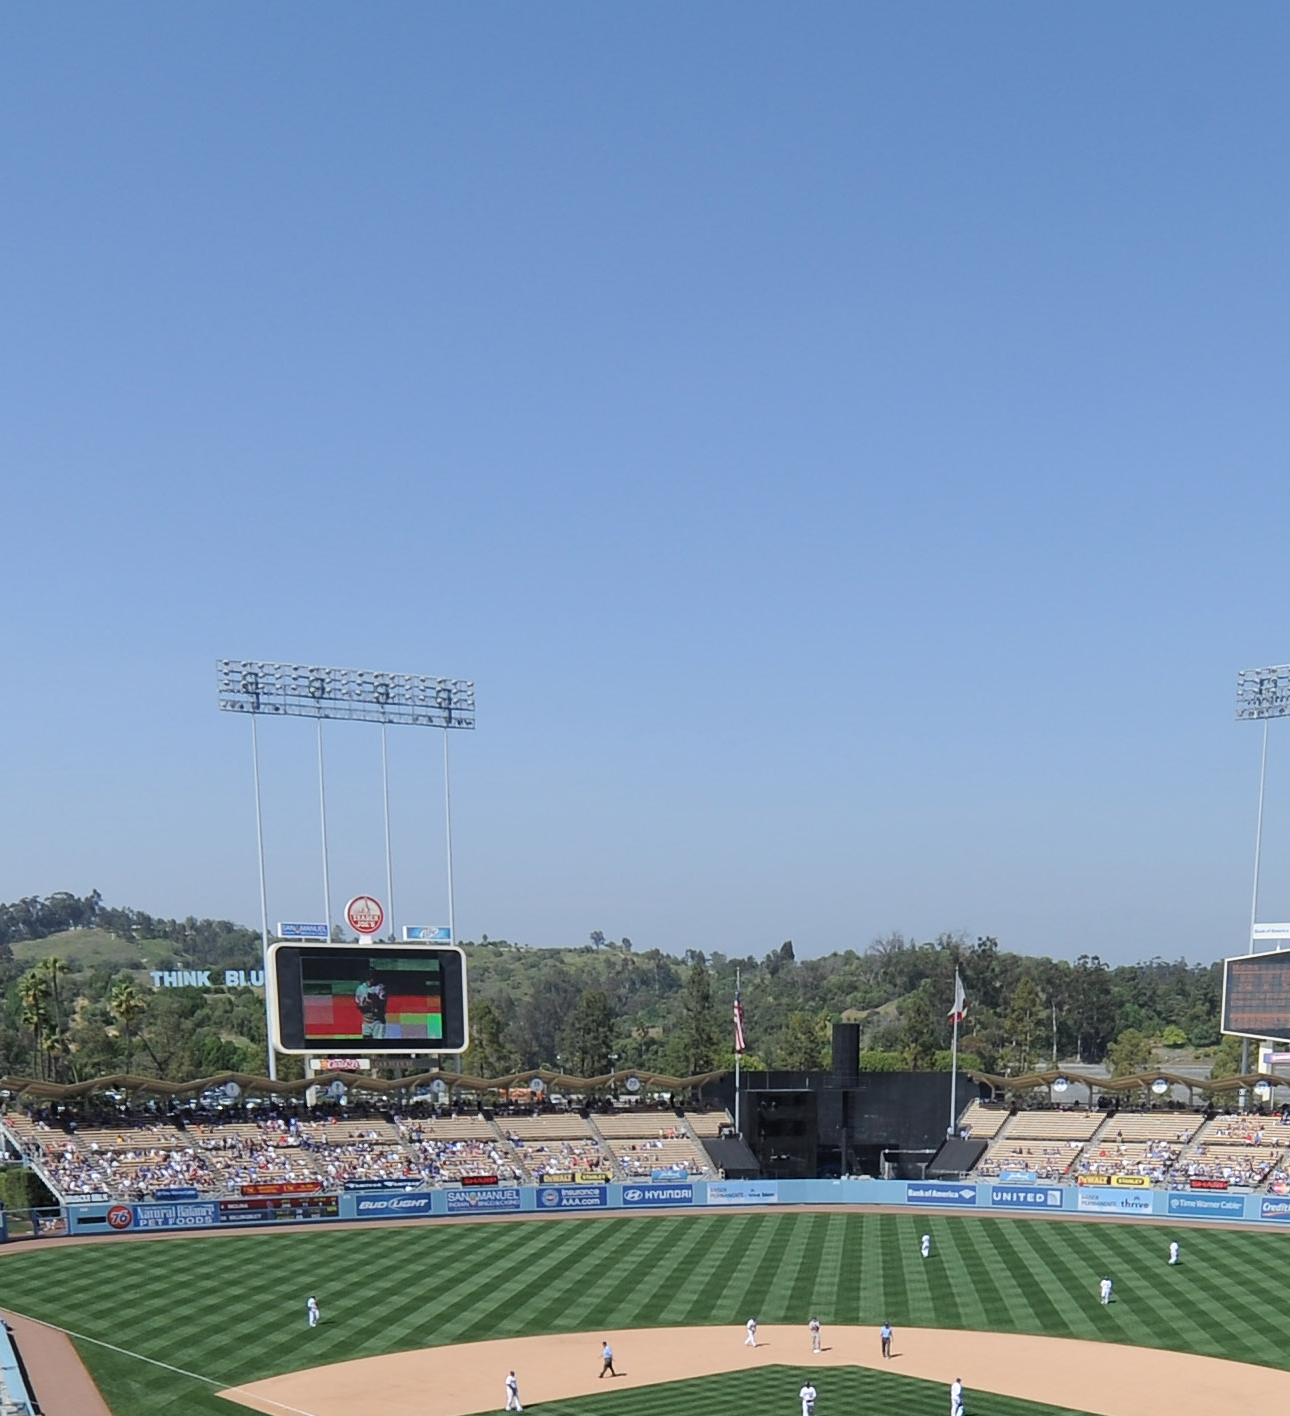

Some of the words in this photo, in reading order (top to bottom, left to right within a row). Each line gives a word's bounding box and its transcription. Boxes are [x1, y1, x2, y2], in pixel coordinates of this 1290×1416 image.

[150, 970, 210, 987] THINK
[1191, 1181, 1228, 1189] SHARP
[448, 1191, 469, 1202] SAN
[477, 1190, 519, 1200] MANUEL
[561, 1188, 599, 1196] Insurance
[645, 1190, 691, 1200] HYUNDAI
[907, 1188, 924, 1197] Bank
[932, 1190, 959, 1198] America
[992, 1191, 1045, 1203] UNITED
[358, 1200, 387, 1210] BUD
[391, 1198, 429, 1208] LIGHT
[1121, 1198, 1149, 1209] thrive
[1180, 1200, 1195, 1208] Time
[1195, 1201, 1220, 1209] Warner
[1221, 1201, 1242, 1210] Cable
[110, 1210, 128, 1225] 76
[137, 1206, 175, 1220] Natural
[139, 1218, 162, 1226] PET
[168, 1216, 213, 1226] FOODS
